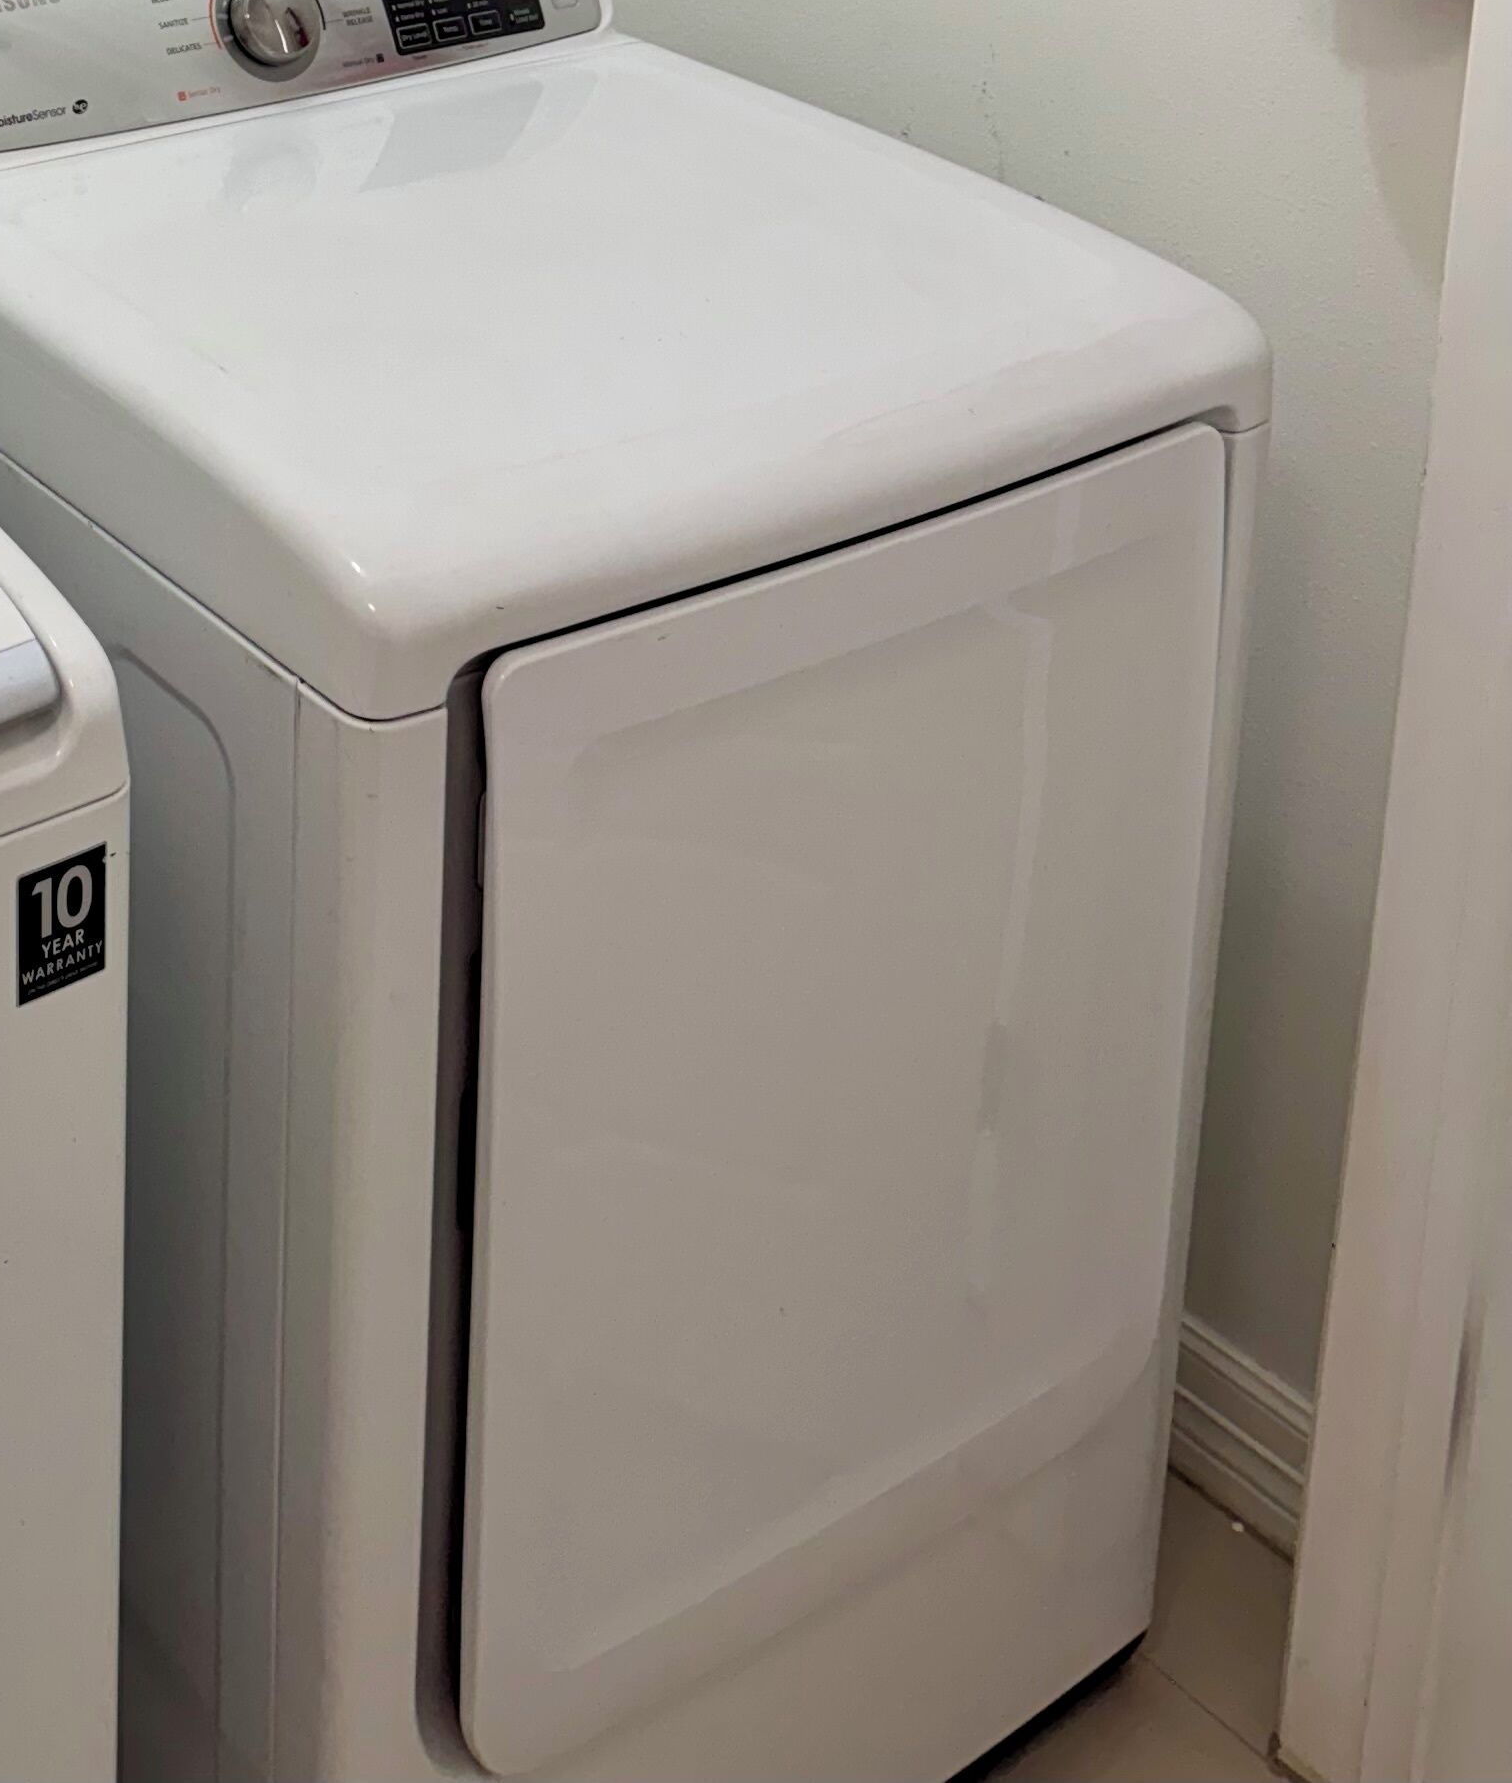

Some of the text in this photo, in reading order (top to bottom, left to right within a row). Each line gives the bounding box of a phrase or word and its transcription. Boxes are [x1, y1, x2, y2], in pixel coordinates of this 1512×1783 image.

[166, 42, 202, 56] DELICATES
[32, 864, 92, 938] 10
[22, 940, 103, 985] WARRANTY
[42, 928, 85, 959] YEAR
